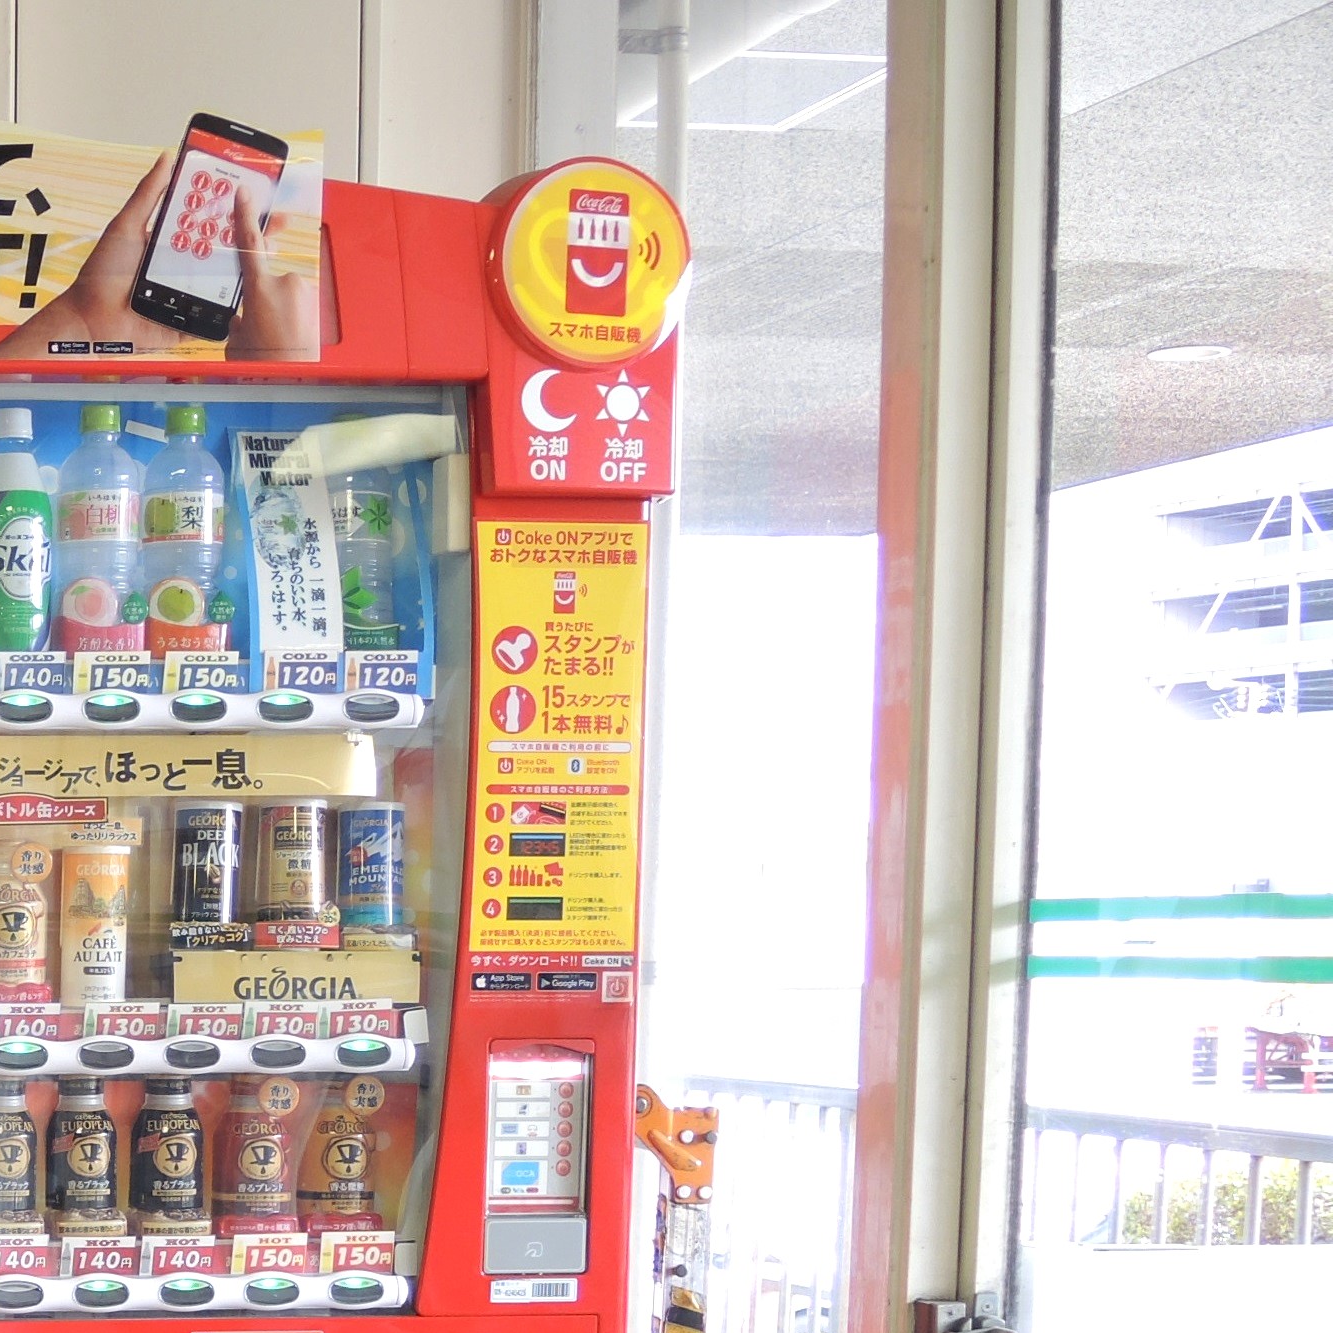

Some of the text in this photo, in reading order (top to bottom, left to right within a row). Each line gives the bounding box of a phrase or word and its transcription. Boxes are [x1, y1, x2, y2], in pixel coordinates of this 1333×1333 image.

[576, 194, 623, 213] Coca-Cola
[549, 322, 641, 343] スマホ自販機
[528, 436, 643, 459] 冷却 冷却
[530, 460, 646, 483] ON OFF
[181, 506, 203, 529] 梨
[515, 530, 633, 545] Coke ONアプリで
[490, 550, 637, 565] おトクなスマホ自販機
[545, 622, 594, 632] 買うたびに
[544, 634, 634, 654] スタンプが
[10, 668, 62, 686] 140円
[95, 668, 148, 687] 150円
[183, 668, 236, 686] 150円
[283, 666, 335, 684] 120円
[364, 667, 416, 685] 120円
[542, 685, 631, 708] 15スタンプで
[492, 807, 498, 820] 1
[490, 838, 499, 851] 2
[21, 850, 43, 861] 香り
[488, 870, 497, 884] 3
[486, 903, 495, 915] 4
[74, 951, 122, 962] AU LAIT
[552, 979, 594, 989] Google Play
[102, 1017, 155, 1035] 130円
[185, 1018, 237, 1036] 130円
[262, 1016, 314, 1034] 130円
[336, 1015, 389, 1032] 130円
[62, 1120, 113, 1132] EUROPEAN
[250, 1249, 303, 1267] 150円
[338, 1247, 391, 1264] 150円
